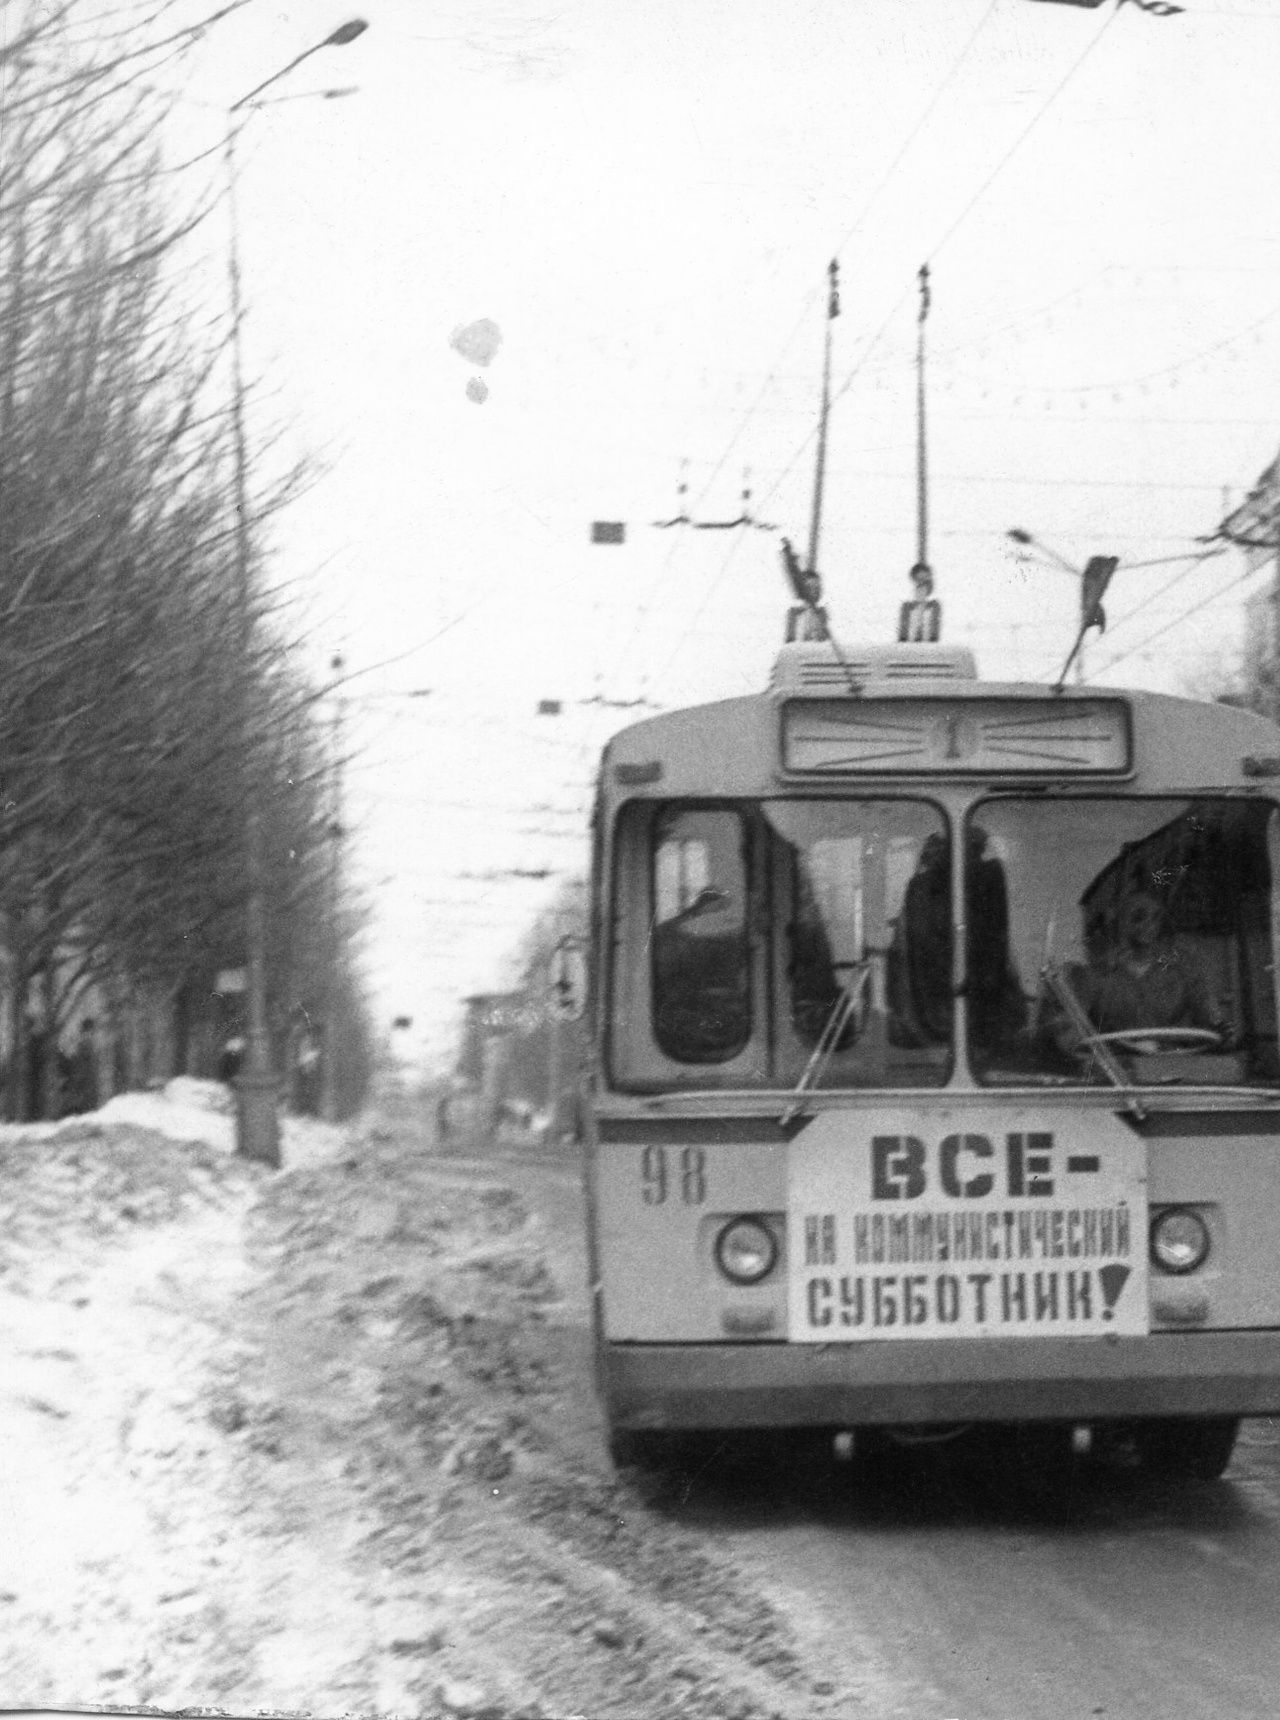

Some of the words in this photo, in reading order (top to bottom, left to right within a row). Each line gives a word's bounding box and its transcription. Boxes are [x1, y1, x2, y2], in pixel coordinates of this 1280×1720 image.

[641, 1145, 706, 1205] 98
[871, 1131, 1101, 1200] ВСЕ-
[806, 1263, 1133, 1327] СУББОТНИК!
